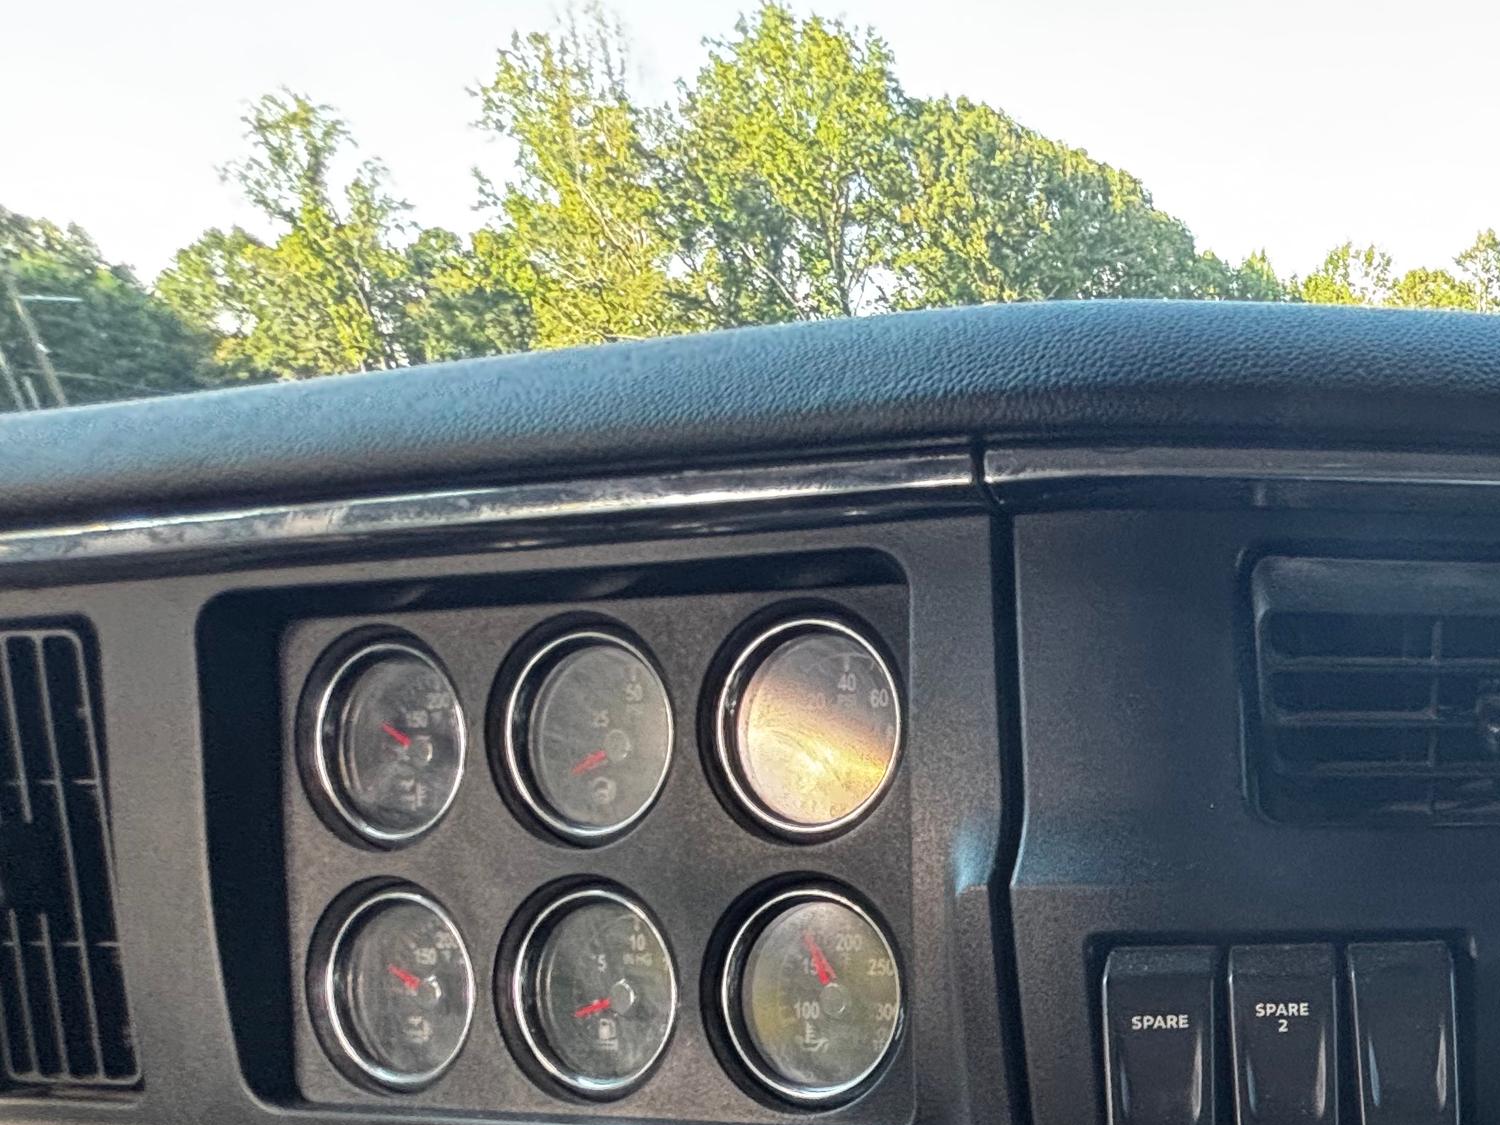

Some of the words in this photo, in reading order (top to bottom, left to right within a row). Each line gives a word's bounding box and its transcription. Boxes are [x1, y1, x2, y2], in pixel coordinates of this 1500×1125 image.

[837, 673, 857, 692] 40
[870, 688, 889, 708] 60
[629, 934, 646, 951] 10
[835, 935, 862, 951] 200
[597, 953, 607, 972] 5
[794, 1001, 820, 1019] 100
[1255, 1001, 1310, 1018] SPARE
[1131, 1013, 1190, 1030] SPARE
[1277, 1019, 1290, 1034] 2
